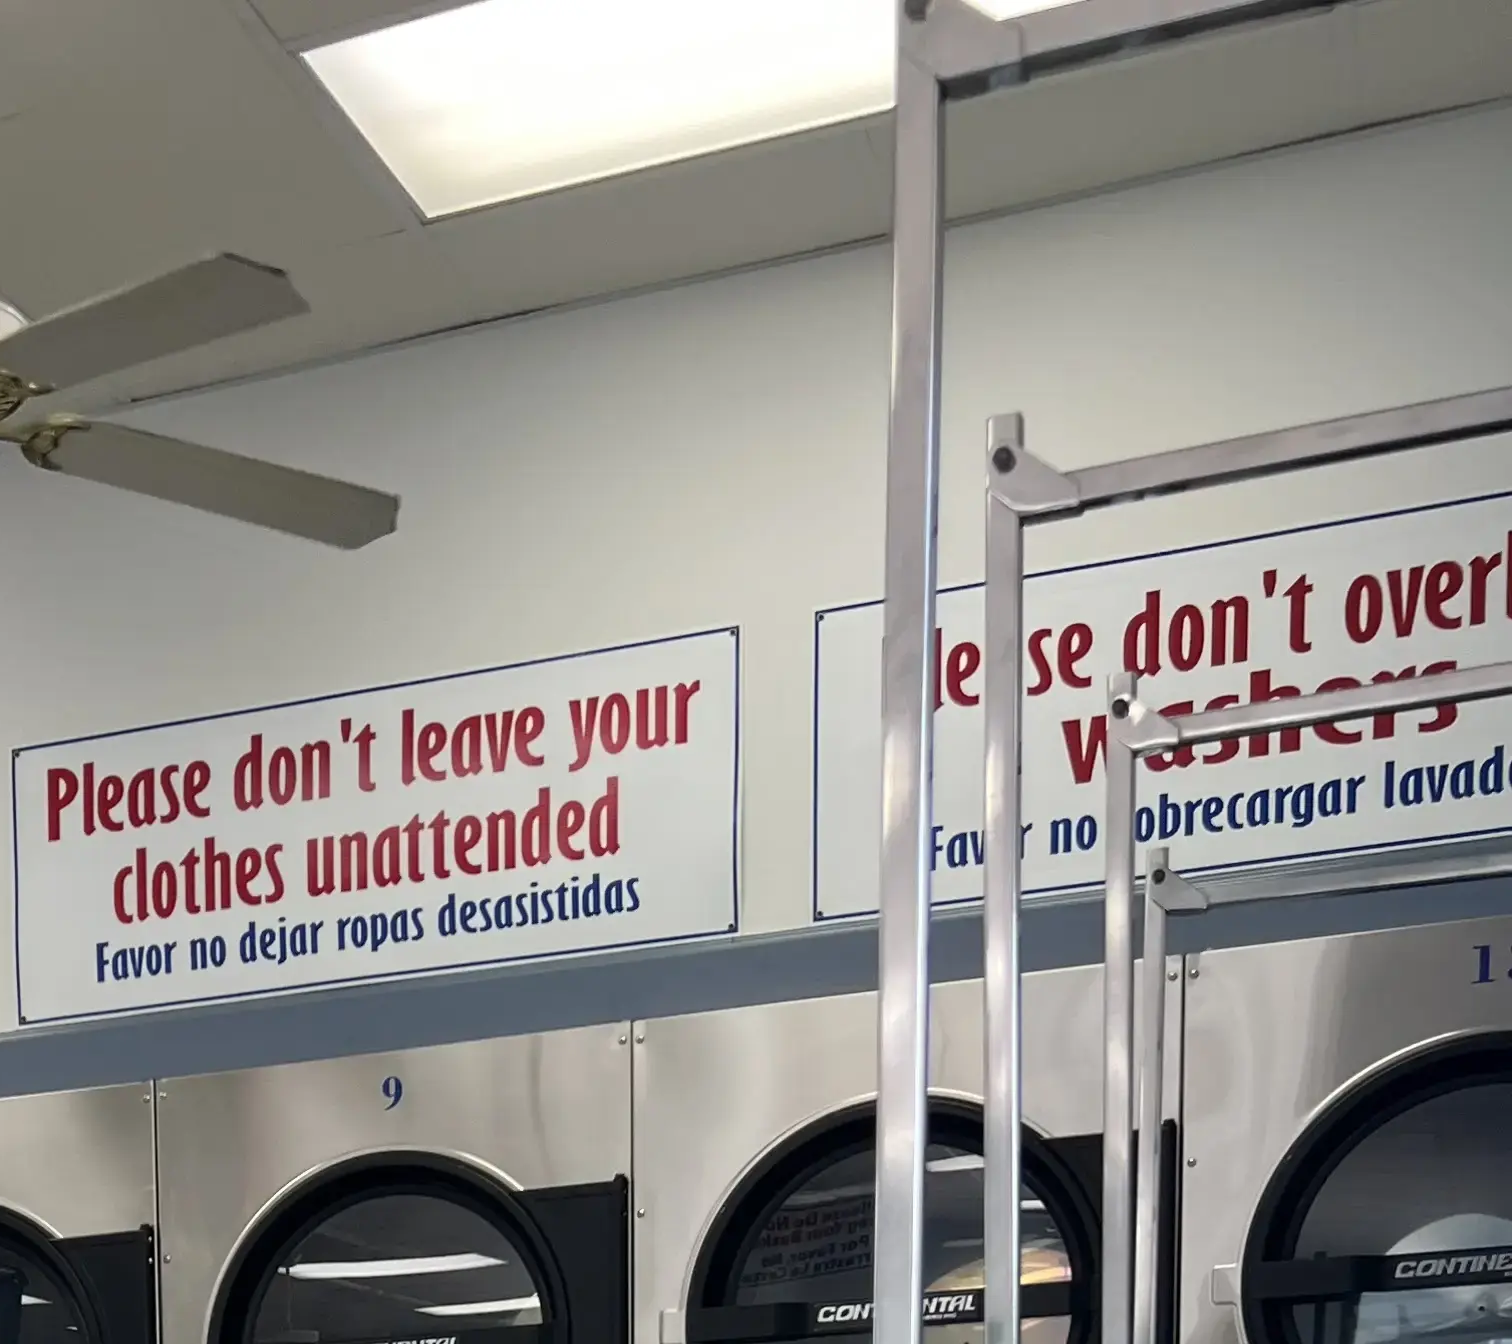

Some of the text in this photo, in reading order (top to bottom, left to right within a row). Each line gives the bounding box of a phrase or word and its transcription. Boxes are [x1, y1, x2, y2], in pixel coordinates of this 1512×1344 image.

[933, 621, 1094, 712] lese
[1122, 568, 1315, 681] don't
[47, 679, 702, 843] Please don't leave your
[929, 744, 1512, 871] Favr no obrecargar lavad
[113, 776, 621, 925] clothes unattended
[95, 873, 640, 983] Favor no dejar ropas desasistidas
[382, 1076, 403, 1110] 9
[816, 1294, 976, 1323] CONNTAL
